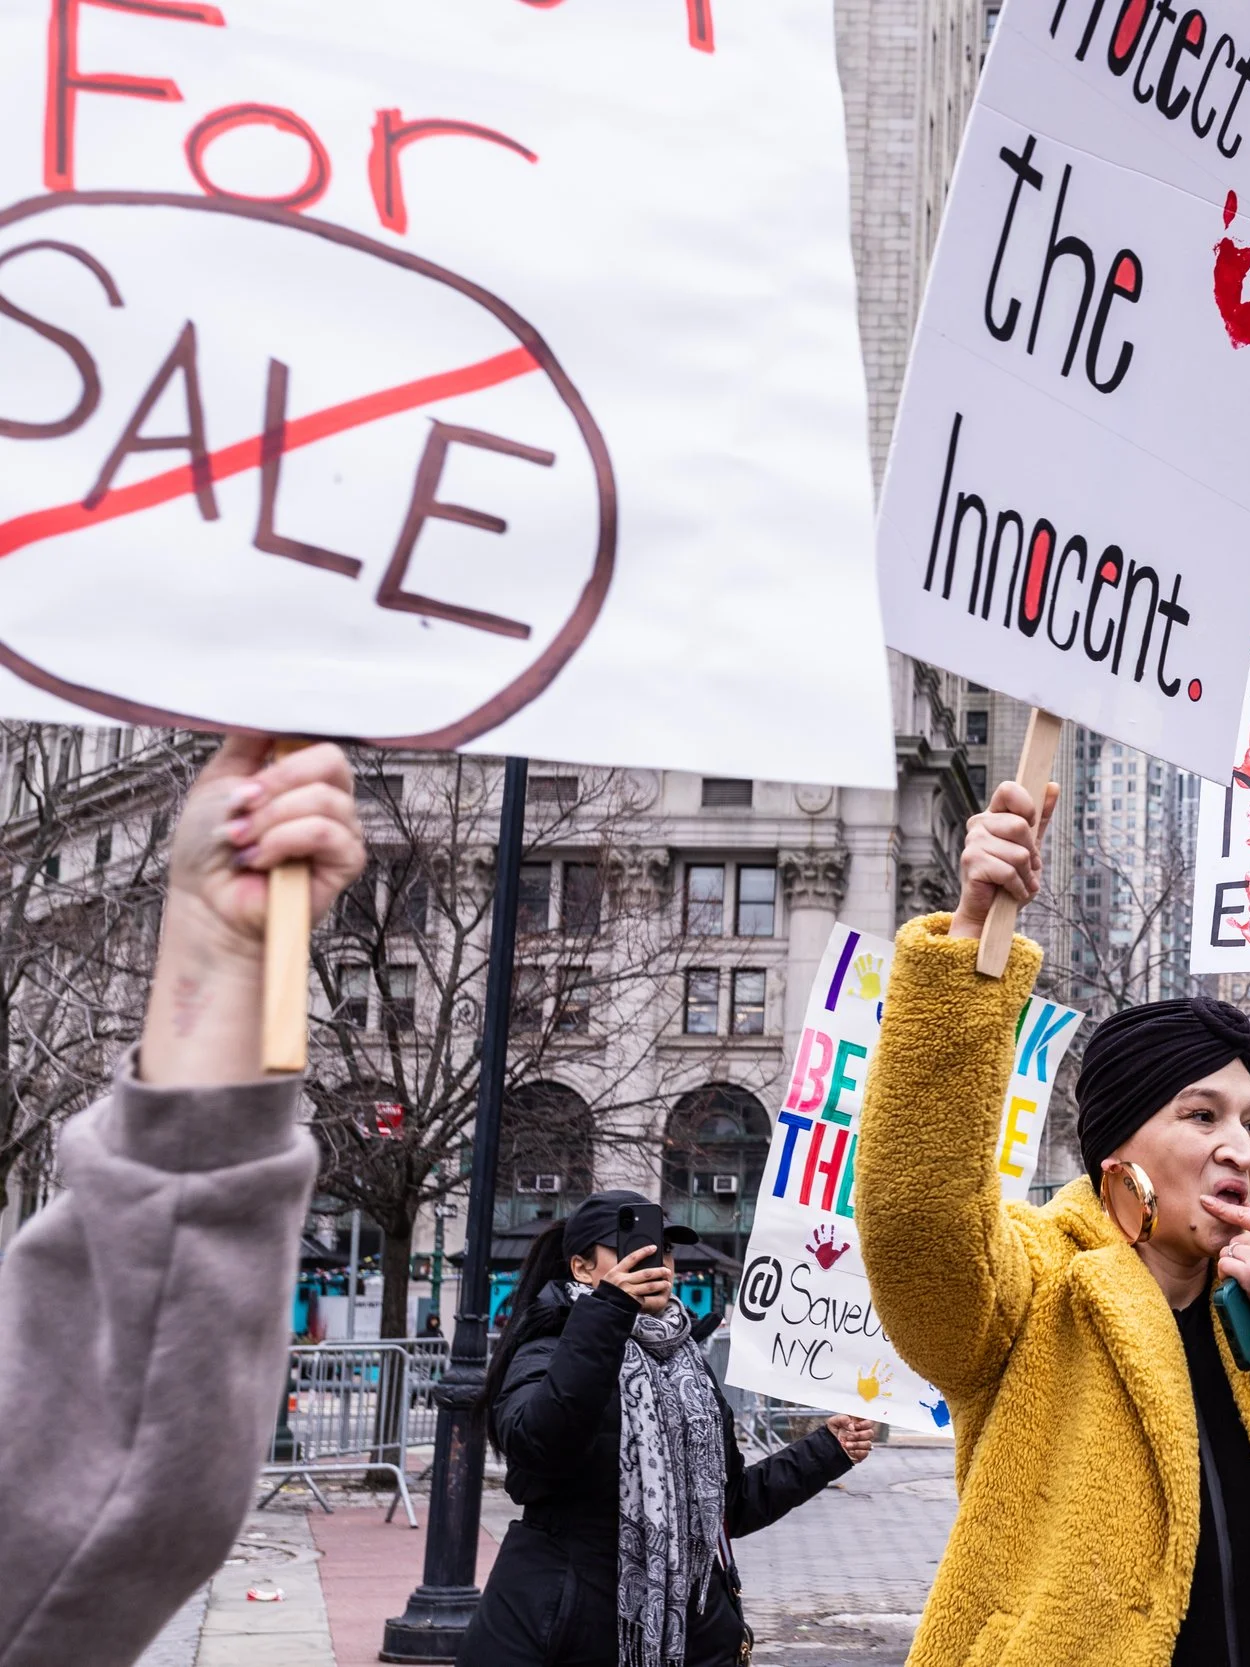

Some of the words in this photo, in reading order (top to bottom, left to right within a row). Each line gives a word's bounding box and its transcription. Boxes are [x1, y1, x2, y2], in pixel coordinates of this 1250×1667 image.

[44, 0, 539, 235] For
[984, 134, 1142, 394] the
[0, 240, 556, 641] SALE
[922, 412, 1202, 702] Innocent.
[825, 931, 861, 1012] I
[772, 1332, 834, 1380] NYC
